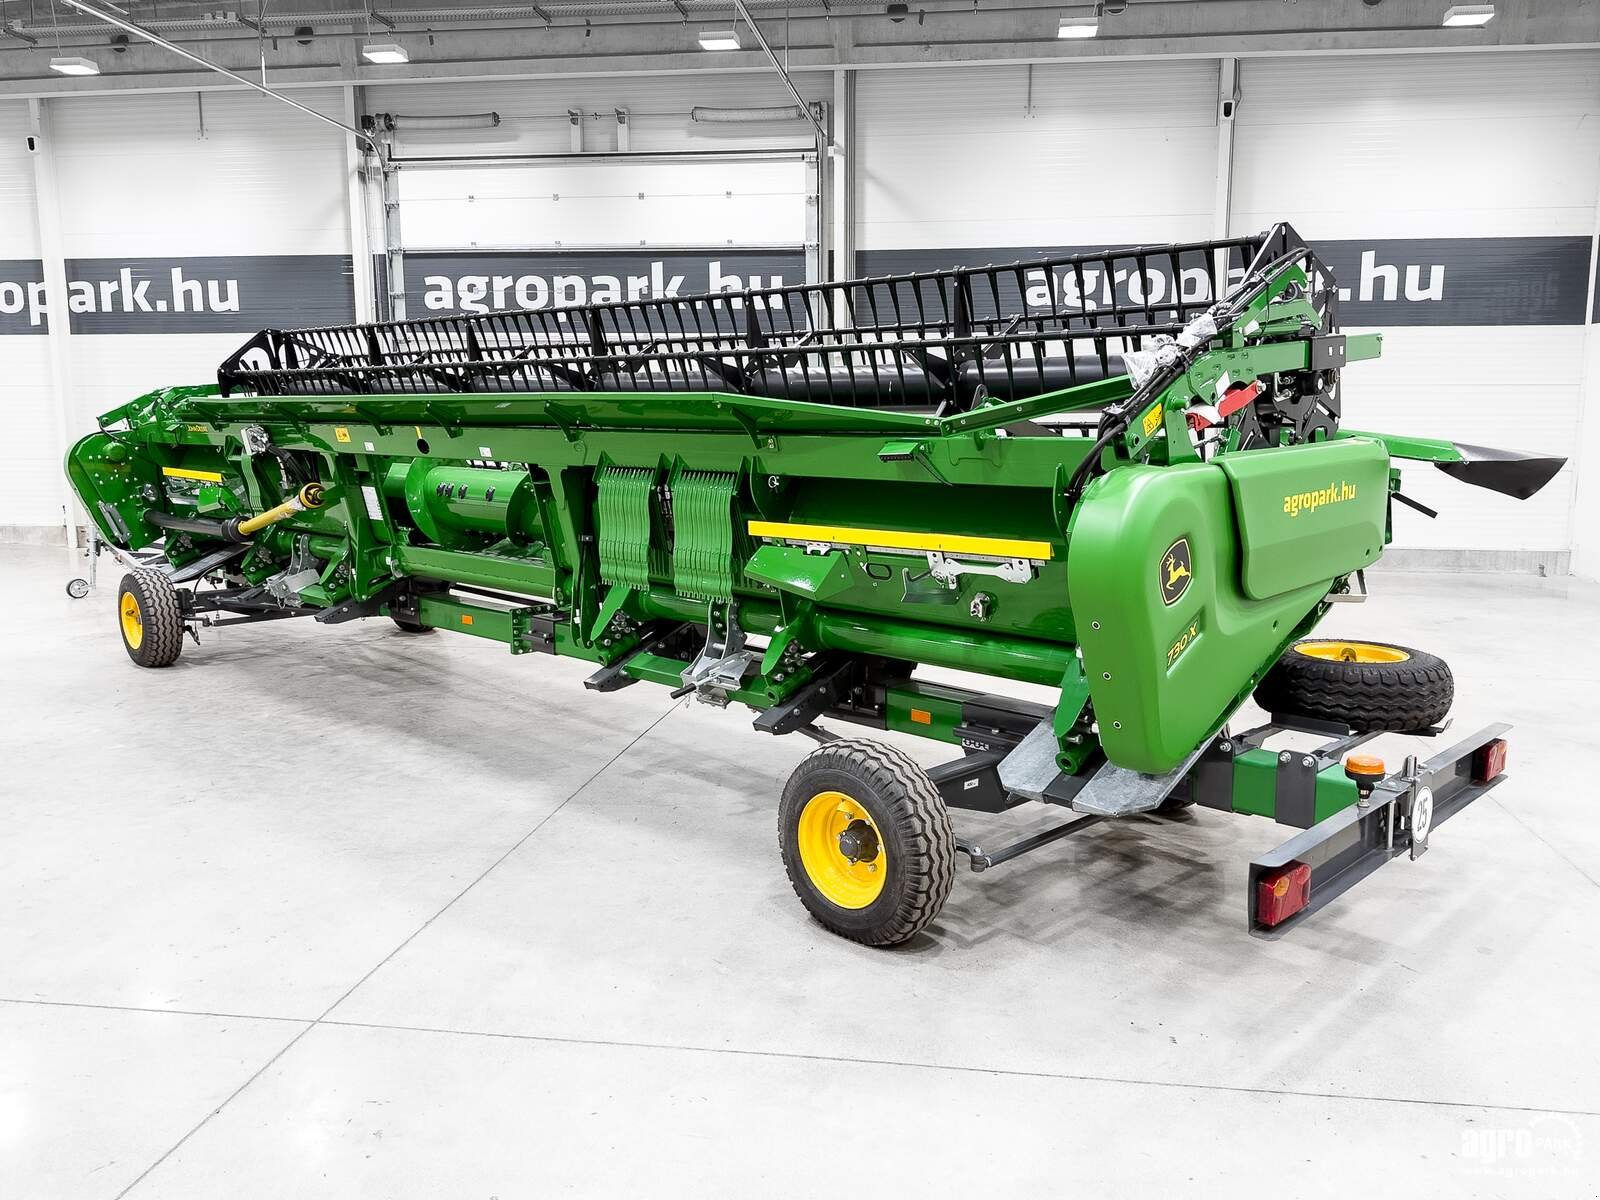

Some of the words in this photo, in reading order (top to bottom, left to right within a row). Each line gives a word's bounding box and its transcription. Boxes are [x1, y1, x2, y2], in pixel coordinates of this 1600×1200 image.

[1026, 250, 1444, 318] agrop.hu
[1283, 481, 1356, 516] agropark.hu
[1167, 633, 1188, 666] 730
[1189, 621, 1198, 641] X
[1417, 796, 1428, 832] 25
